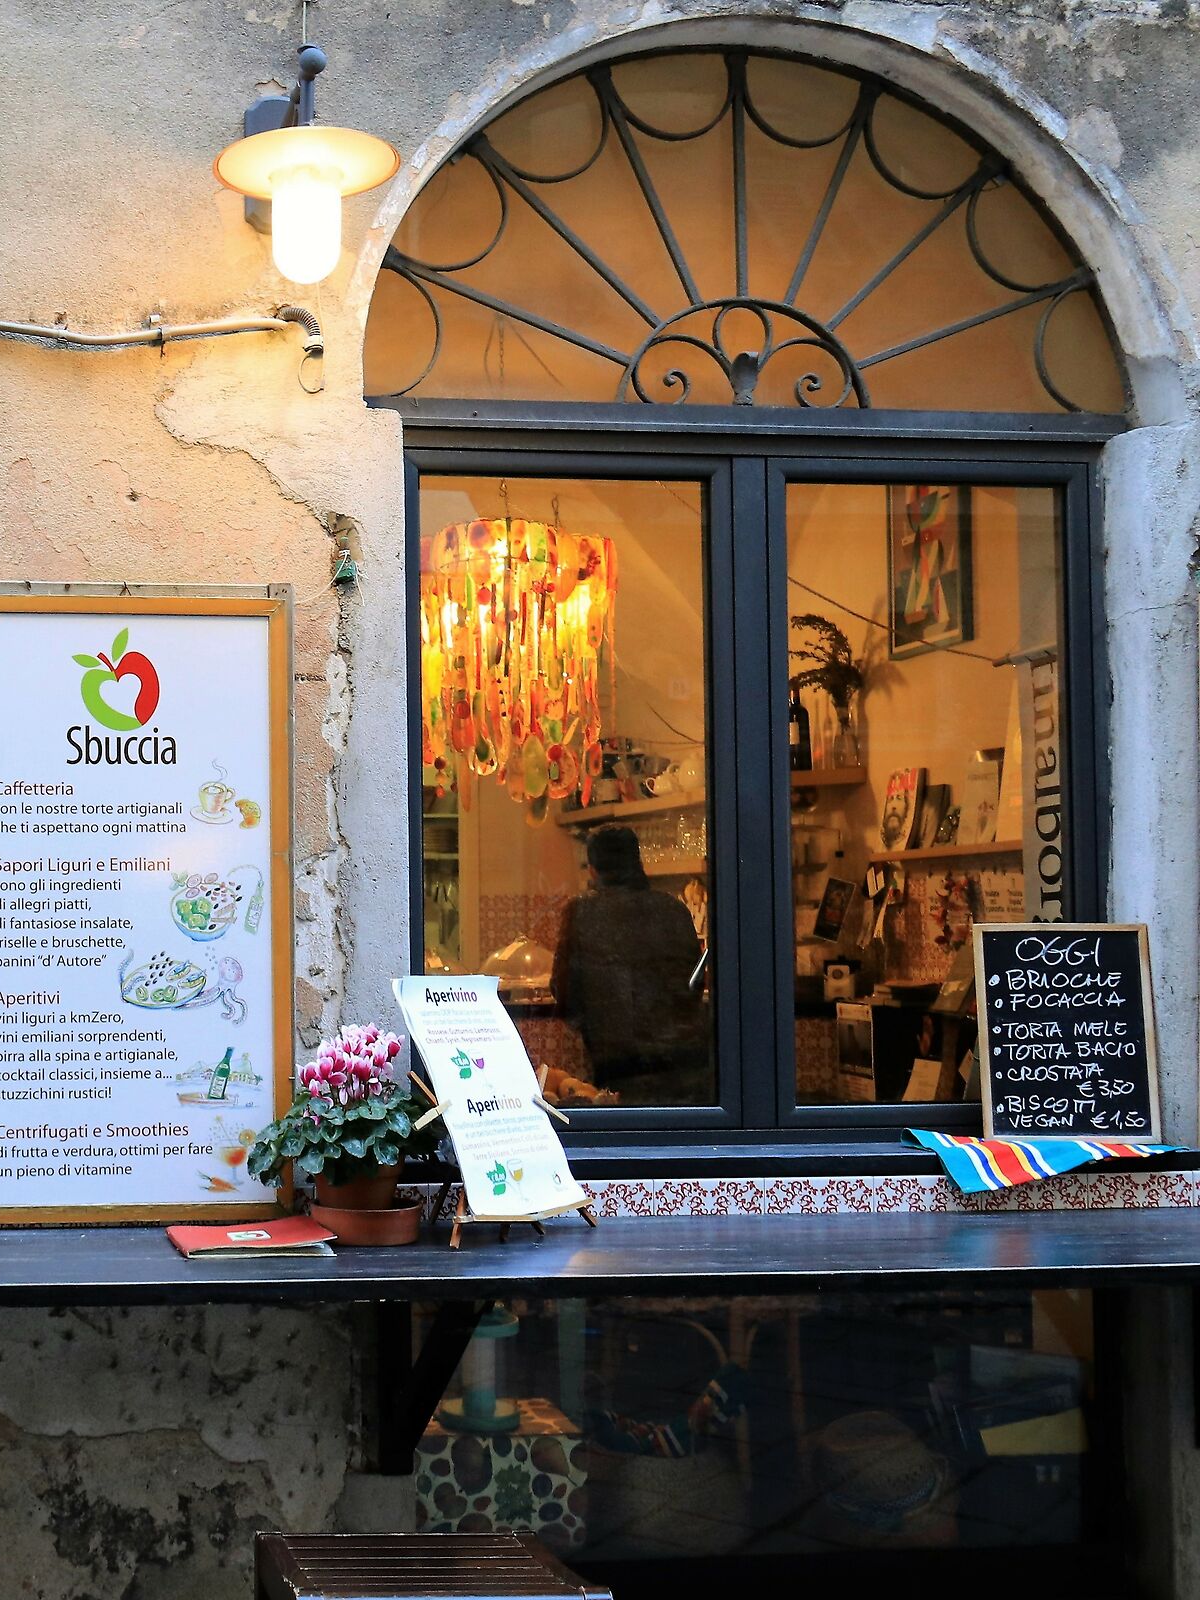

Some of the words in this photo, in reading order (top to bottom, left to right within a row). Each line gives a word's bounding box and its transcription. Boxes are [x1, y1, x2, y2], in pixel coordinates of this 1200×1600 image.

[66, 725, 177, 765] Sbuccia
[36, 804, 78, 815] nostre
[81, 804, 114, 814] torte
[116, 802, 182, 817] artigianali
[32, 823, 99, 836] aspettano
[102, 821, 132, 836] ogni
[136, 821, 186, 833] mattina
[48, 858, 91, 875] Liguri
[110, 857, 170, 871] Emiliani
[29, 879, 45, 894] gli
[49, 878, 121, 894] ingredienti
[9, 897, 50, 913] allegri
[54, 898, 91, 913] piatti,
[9, 916, 77, 929] fantasiose
[80, 916, 133, 930] insalate,
[52, 935, 126, 949] bruschette,
[1015, 936, 1101, 967] OGGI
[1005, 969, 1122, 991] BRIOCHE
[425, 987, 478, 1006] Aperivino
[1010, 990, 1126, 1011] FOCACCIA
[22, 1011, 55, 1027] liguri
[70, 1011, 124, 1024] kmZero,
[22, 1030, 74, 1043] emiliani
[78, 1029, 166, 1045] sorprendenti,
[1002, 1021, 1063, 1039] TORTA
[1074, 1020, 1127, 1036] MELE
[28, 1049, 51, 1062] alla
[55, 1049, 90, 1064] spina
[105, 1047, 178, 1064] artigianale,
[1002, 1042, 1071, 1061] TORTA
[1075, 1041, 1136, 1058] BACIO
[48, 1068, 98, 1081] classici,
[100, 1067, 152, 1080] insieme
[155, 1070, 172, 1079] a...
[1007, 1062, 1104, 1082] CROSTATA
[68, 1086, 111, 1099] rustici!
[466, 1094, 522, 1117] Aperivino
[1004, 1094, 1096, 1113] BISCOTTI
[1008, 1114, 1074, 1128] VEGAN
[106, 1122, 189, 1137] Smoothies
[11, 1145, 48, 1158] frutta
[62, 1144, 117, 1158] verdura,
[119, 1143, 159, 1156] ottimi
[163, 1146, 185, 1158] per
[188, 1142, 213, 1155] fare
[17, 1164, 55, 1180] pieno
[74, 1163, 132, 1176] vitamine
